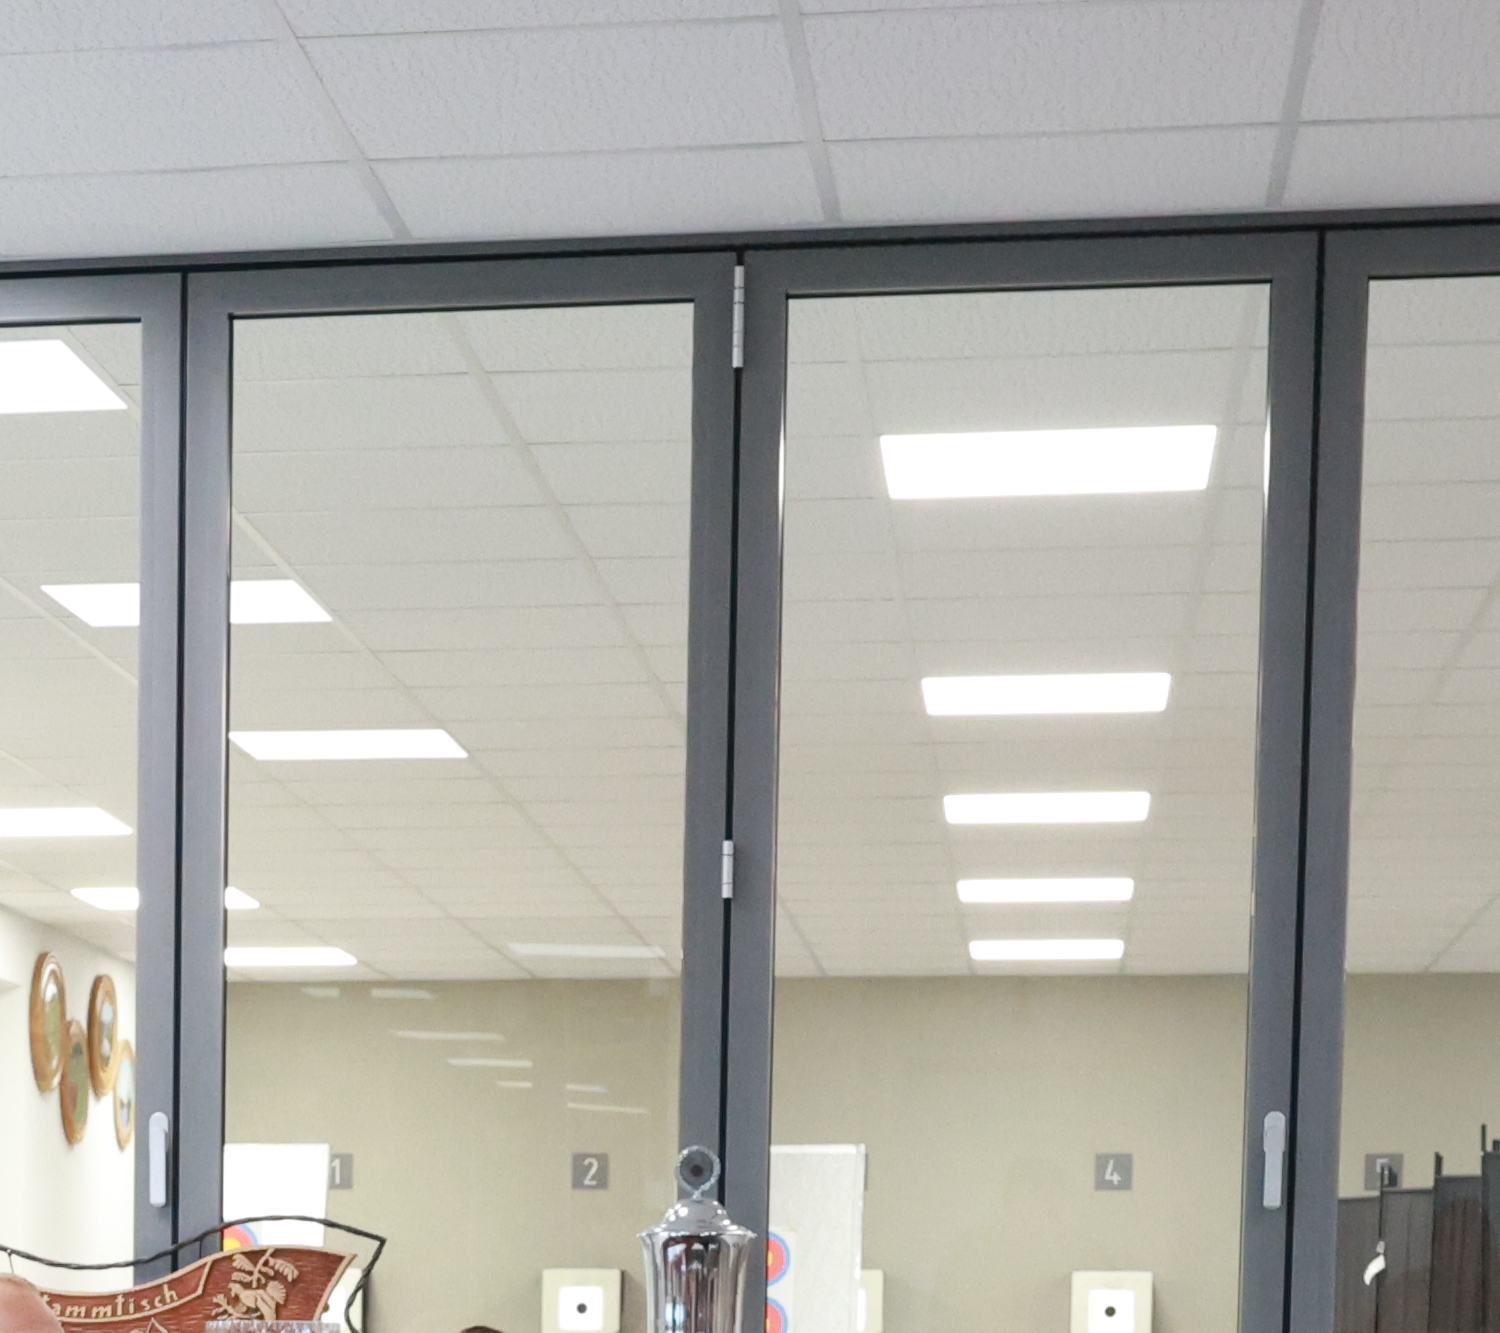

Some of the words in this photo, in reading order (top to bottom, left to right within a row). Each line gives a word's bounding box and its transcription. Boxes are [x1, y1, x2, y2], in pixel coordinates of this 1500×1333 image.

[331, 1157, 341, 1186] 1
[583, 1157, 599, 1186] 2
[1104, 1158, 1122, 1186] 4
[44, 1286, 179, 1318] tammtisch
